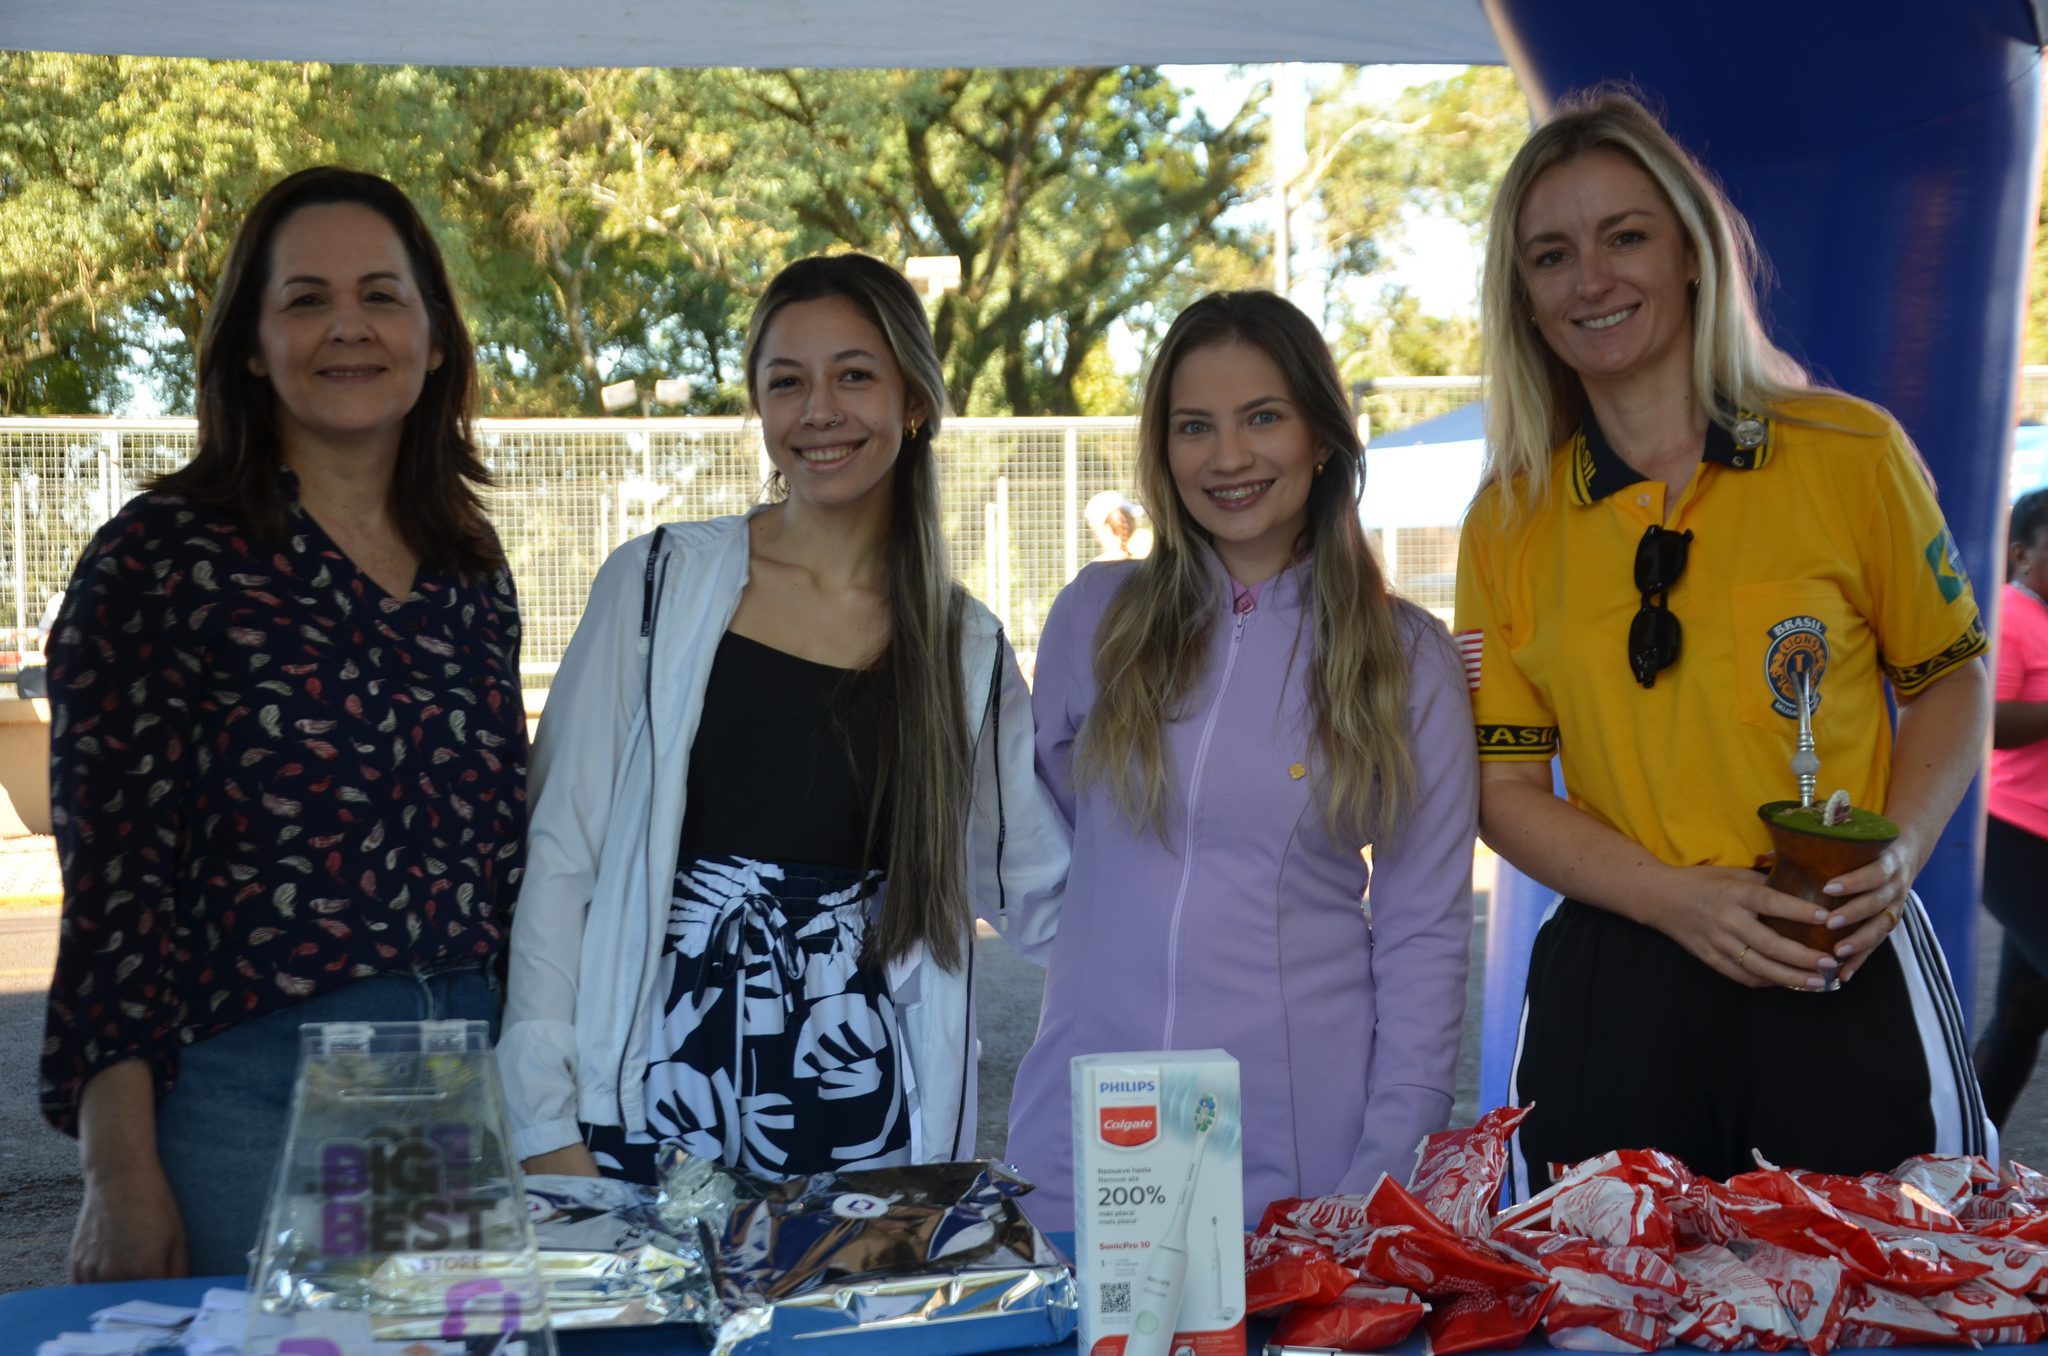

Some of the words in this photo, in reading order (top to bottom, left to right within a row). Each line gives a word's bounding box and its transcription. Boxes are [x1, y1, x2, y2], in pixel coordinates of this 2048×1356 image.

[1774, 617, 1823, 636] BRASIL
[1783, 635, 1819, 650] LIONS
[1891, 624, 1984, 682] RASIL
[1476, 727, 1556, 744] RASIL
[1099, 1080, 1156, 1093] PHILIPS
[1103, 1118, 1153, 1131] Colgate
[1098, 1185, 1166, 1206] 200%
[320, 1199, 496, 1256] BEST
[1099, 1241, 1138, 1250] SonicPro
[1140, 1240, 1151, 1249] 10
[421, 1253, 483, 1271] STORE
